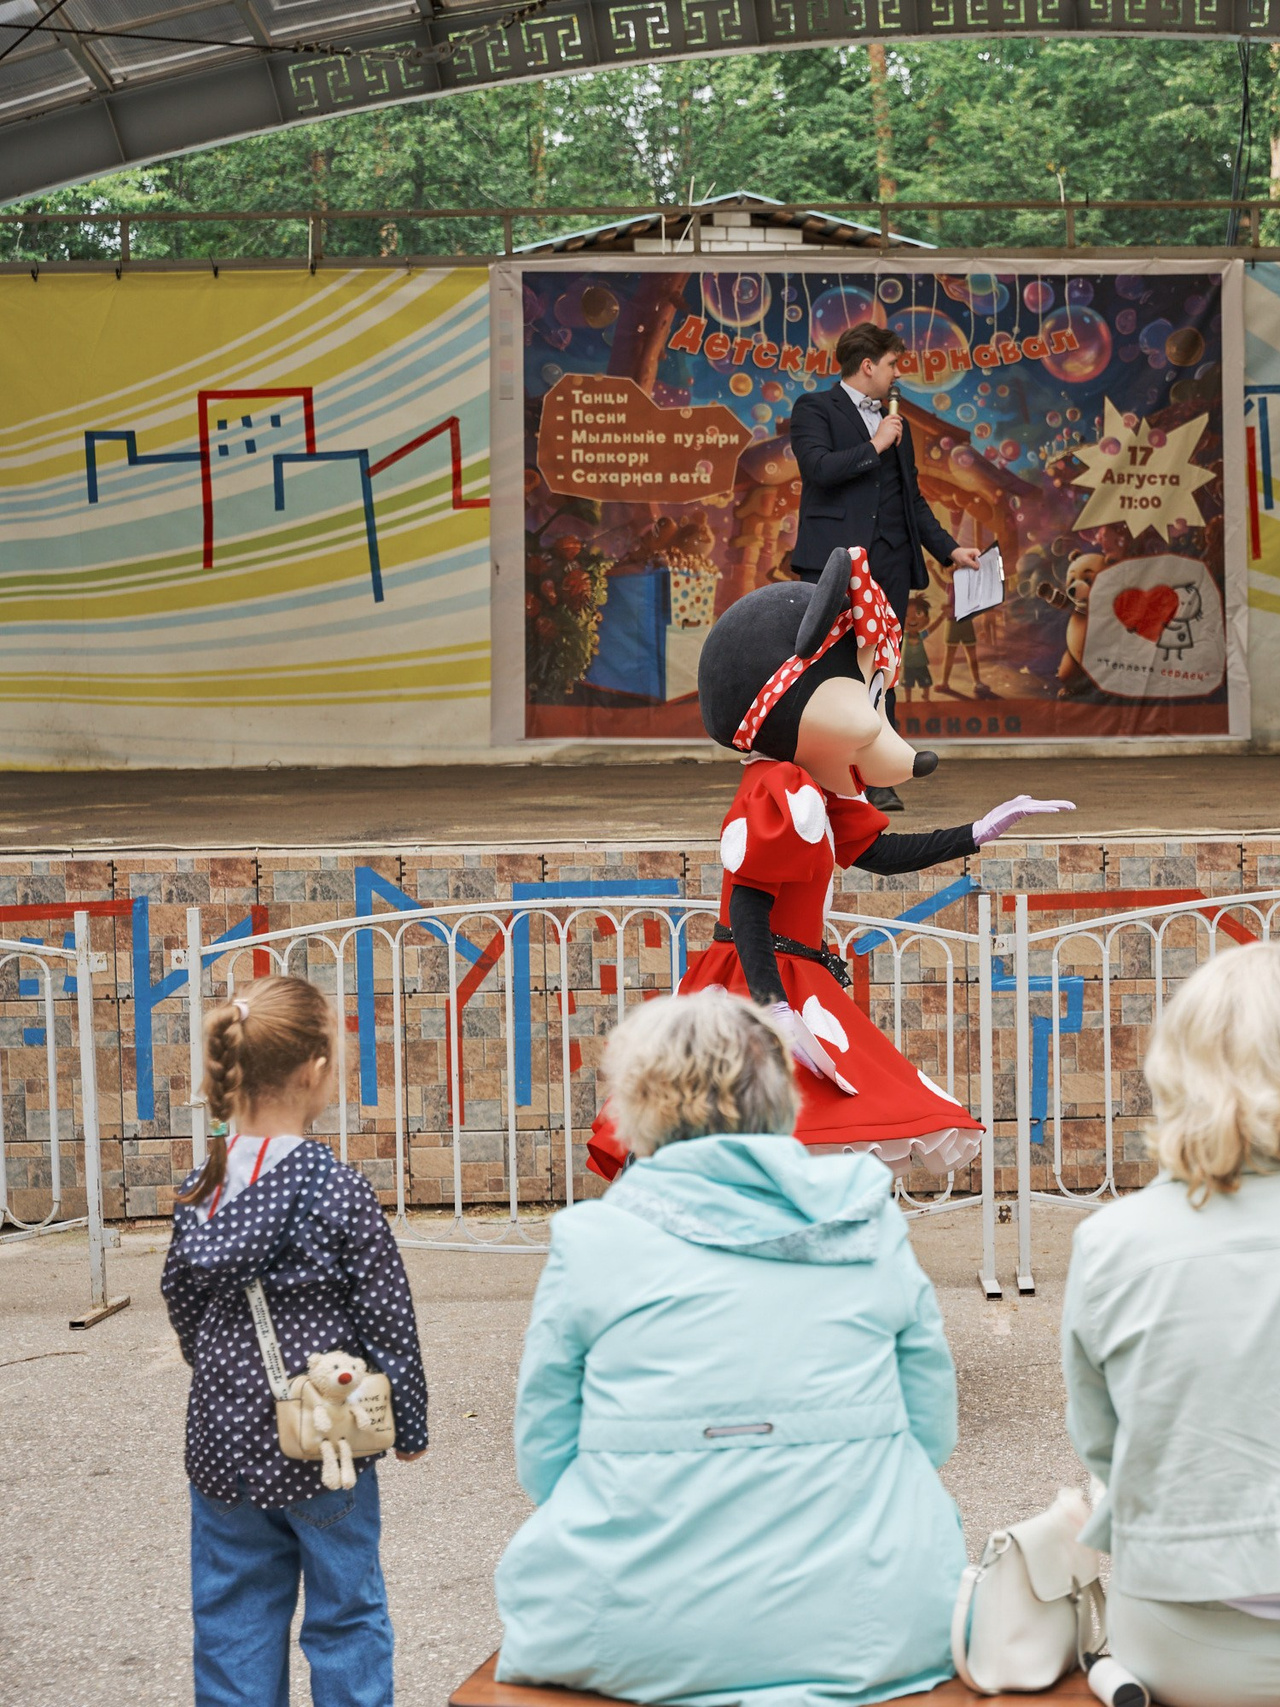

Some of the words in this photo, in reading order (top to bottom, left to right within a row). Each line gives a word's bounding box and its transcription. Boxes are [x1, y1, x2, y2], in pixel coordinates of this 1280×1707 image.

[899, 328, 1081, 384] арнавал
[571, 390, 628, 405] Танцы
[571, 410, 626, 424] Песни
[673, 434, 739, 448] пузыри
[571, 449, 649, 467] Попкорн
[1127, 446, 1154, 466] 17
[571, 469, 663, 487] Сахарная
[670, 473, 711, 484] вата
[1101, 468, 1180, 490] Августа
[1119, 495, 1162, 509] 11:00
[895, 716, 1021, 734] панова
